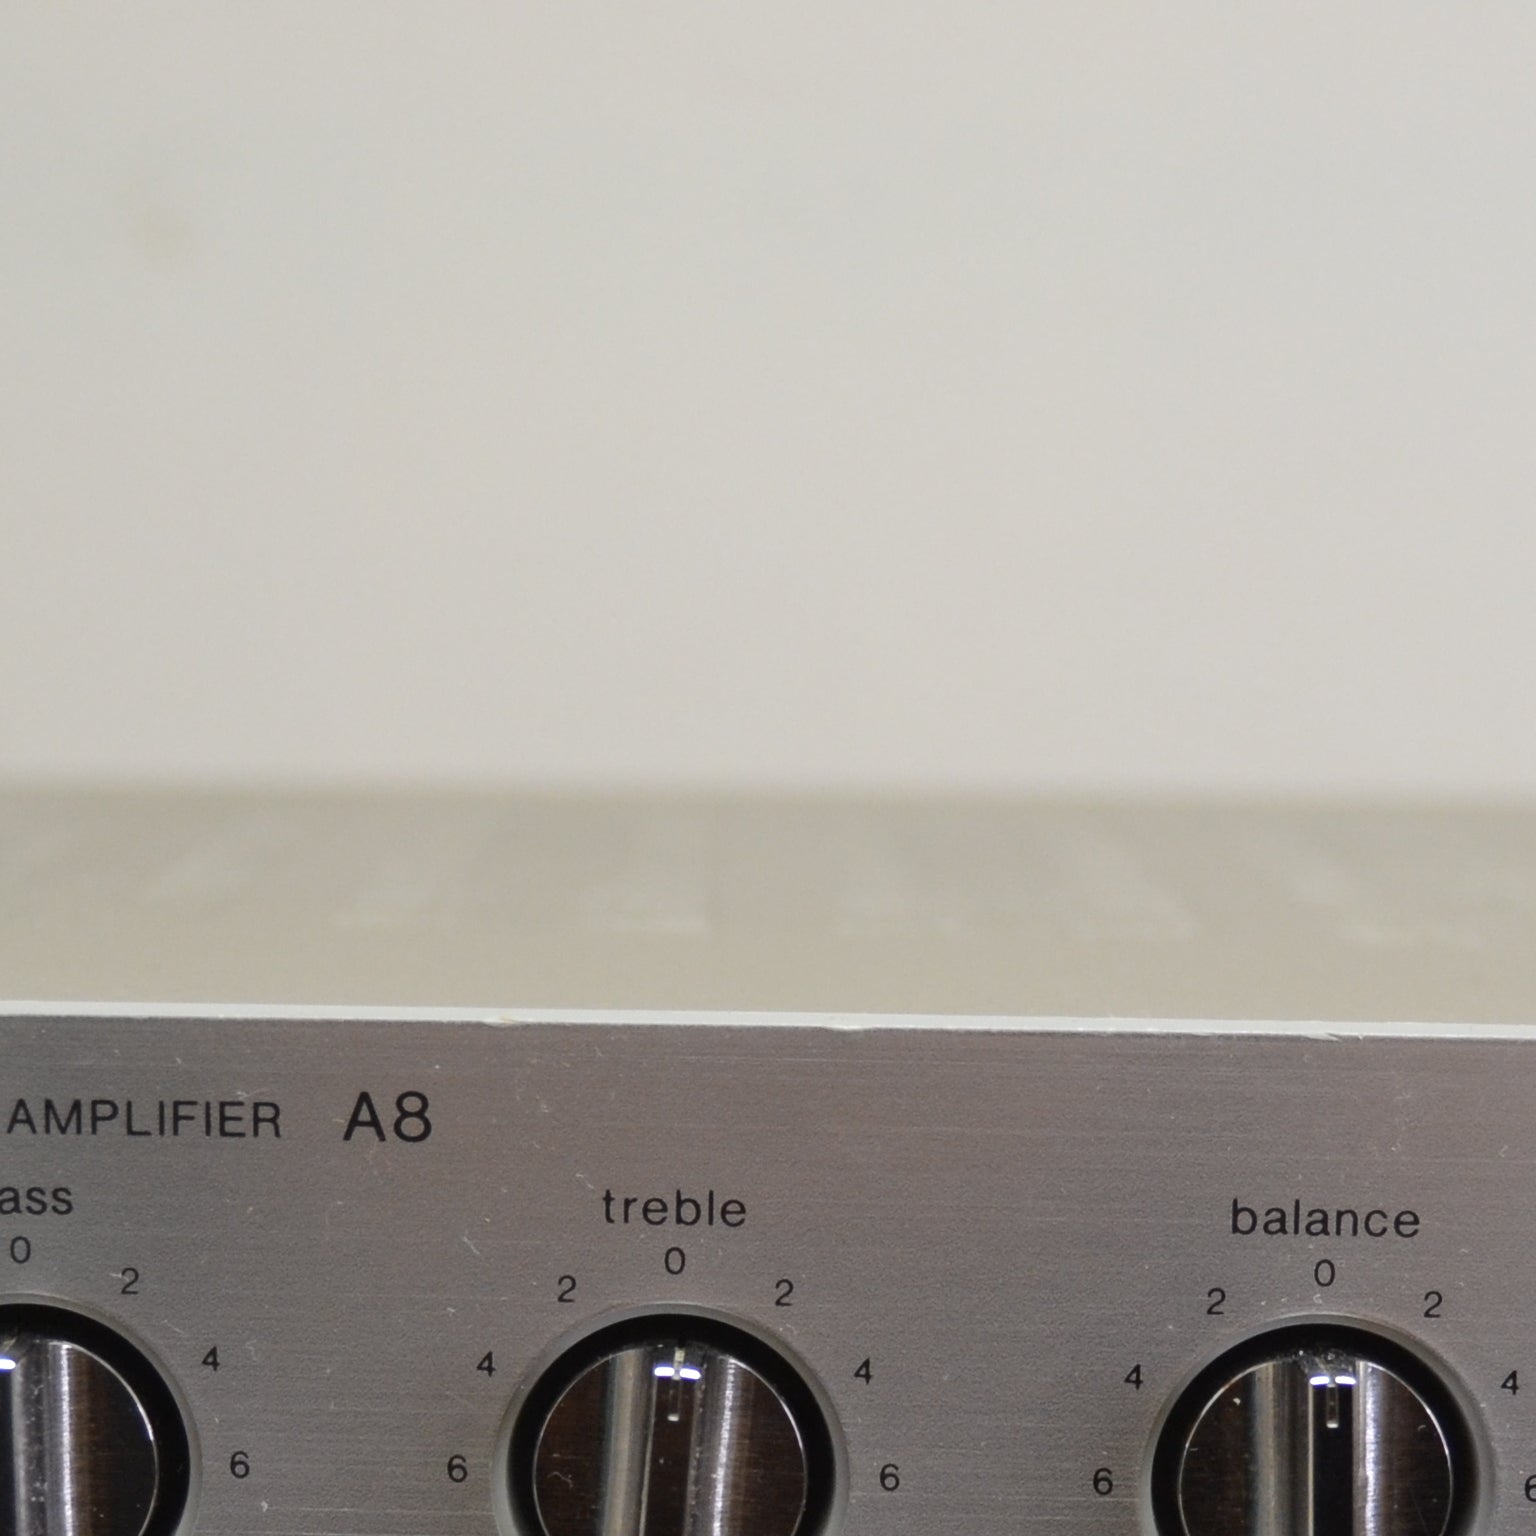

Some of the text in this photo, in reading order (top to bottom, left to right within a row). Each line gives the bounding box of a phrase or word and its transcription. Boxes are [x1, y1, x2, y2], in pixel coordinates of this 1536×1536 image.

[6, 1098, 281, 1139] AMPLIFIER
[342, 1090, 432, 1144] A8
[602, 1189, 747, 1228] treble
[1231, 1197, 1420, 1239] balance
[9, 1235, 32, 1265] 0
[663, 1246, 687, 1276] 0
[120, 1266, 140, 1296] 2
[1313, 1258, 1336, 1288] 0
[557, 1274, 577, 1304] 2
[774, 1278, 795, 1307] 2
[1206, 1286, 1227, 1316] 2
[1423, 1290, 1443, 1319] 2
[201, 1345, 220, 1372] 4
[476, 1351, 496, 1377] 4
[853, 1358, 873, 1384] 4
[1124, 1364, 1144, 1390] 4
[1500, 1369, 1520, 1396] 4
[229, 1450, 251, 1480] 6
[446, 1454, 469, 1484] 6
[879, 1463, 900, 1492] 6
[1092, 1467, 1114, 1497] 6
